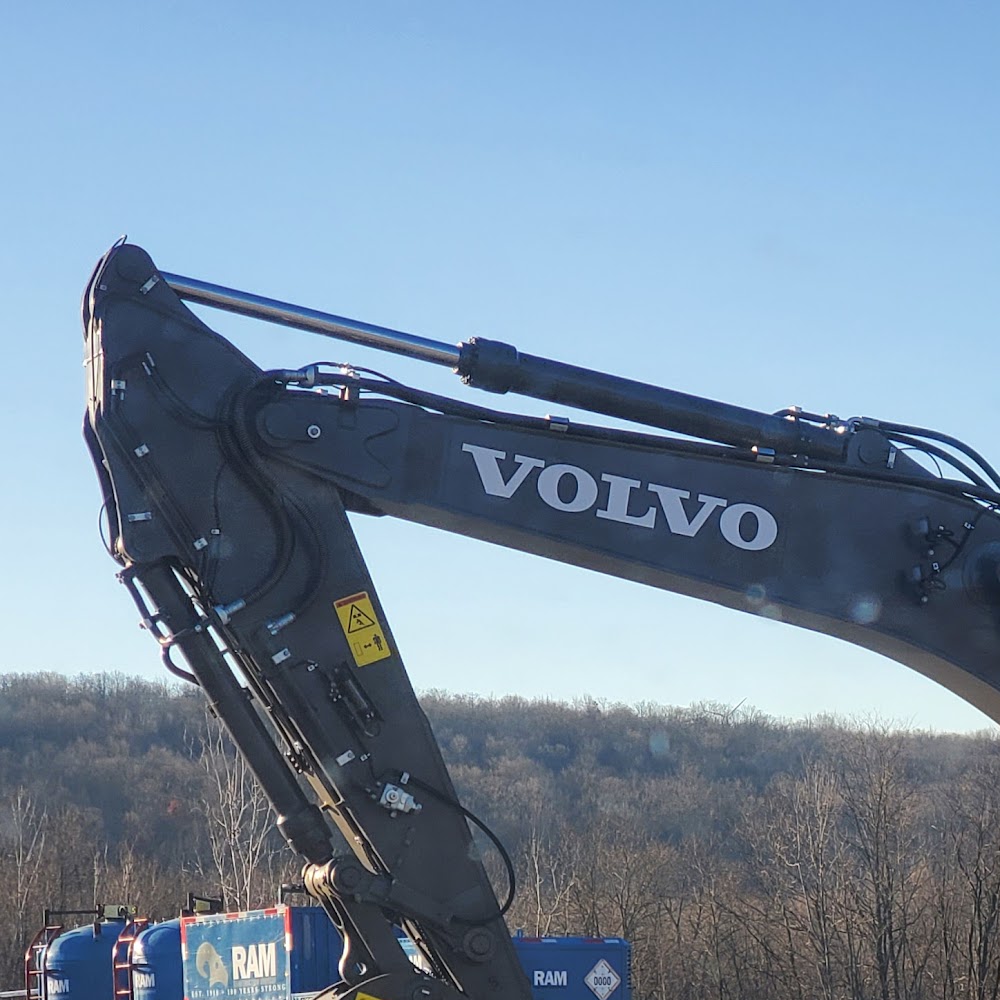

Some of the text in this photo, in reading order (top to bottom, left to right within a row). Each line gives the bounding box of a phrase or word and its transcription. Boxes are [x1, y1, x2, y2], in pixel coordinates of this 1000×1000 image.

[461, 442, 779, 552] VOLVO
[231, 943, 277, 980] RAM
[134, 973, 155, 988] RAM
[533, 970, 568, 987] RAM
[47, 979, 70, 995] RAM
[260, 984, 286, 993] STRONG
